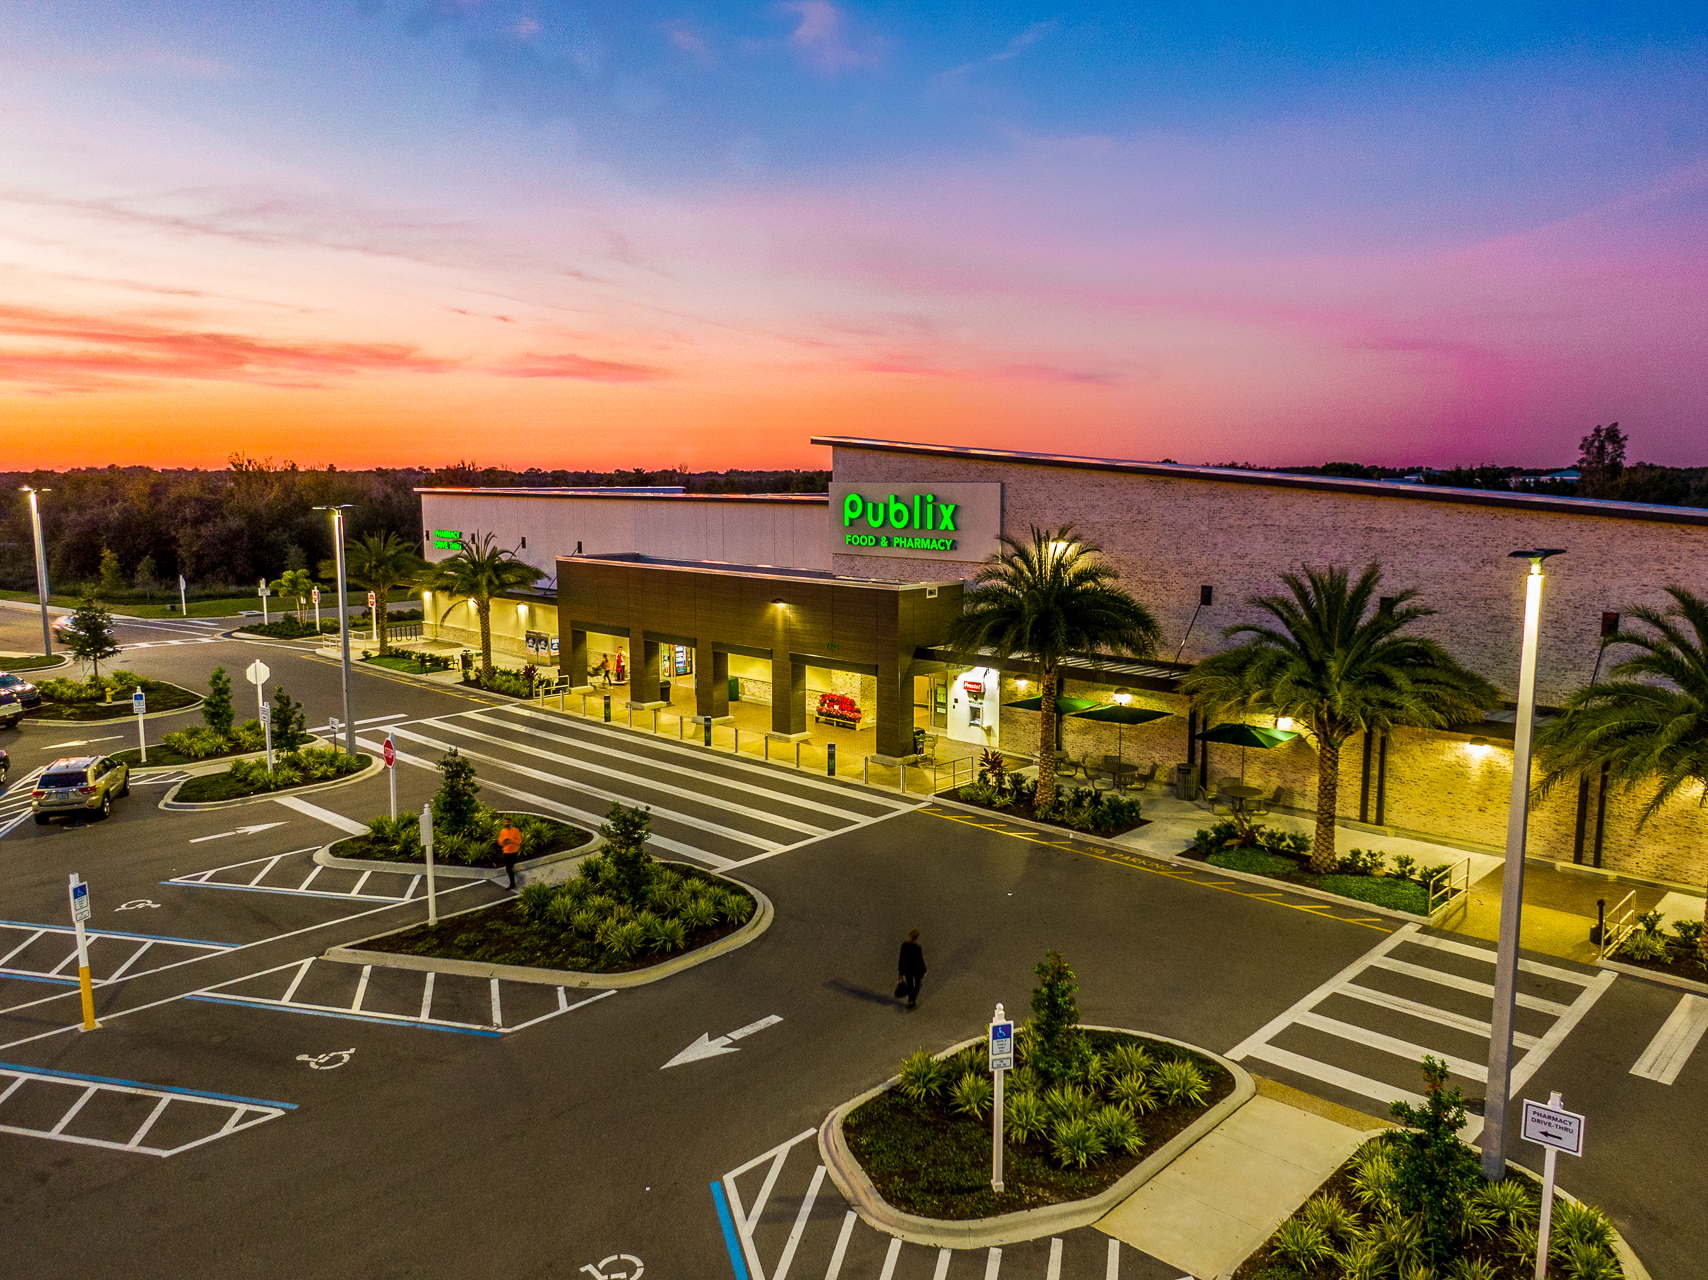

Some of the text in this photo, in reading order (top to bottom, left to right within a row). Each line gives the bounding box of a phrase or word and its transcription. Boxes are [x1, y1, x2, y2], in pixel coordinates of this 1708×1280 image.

[843, 493, 956, 531] Publix
[434, 530, 460, 539] PHARMACY
[845, 534, 953, 551] FOOD & PHARMACY
[384, 746, 393, 758] STOP
[1085, 846, 1173, 871] NO PARKING
[1531, 1117, 1574, 1134] DRIVE-THRU
[1532, 1110, 1573, 1127] PHARMACY
